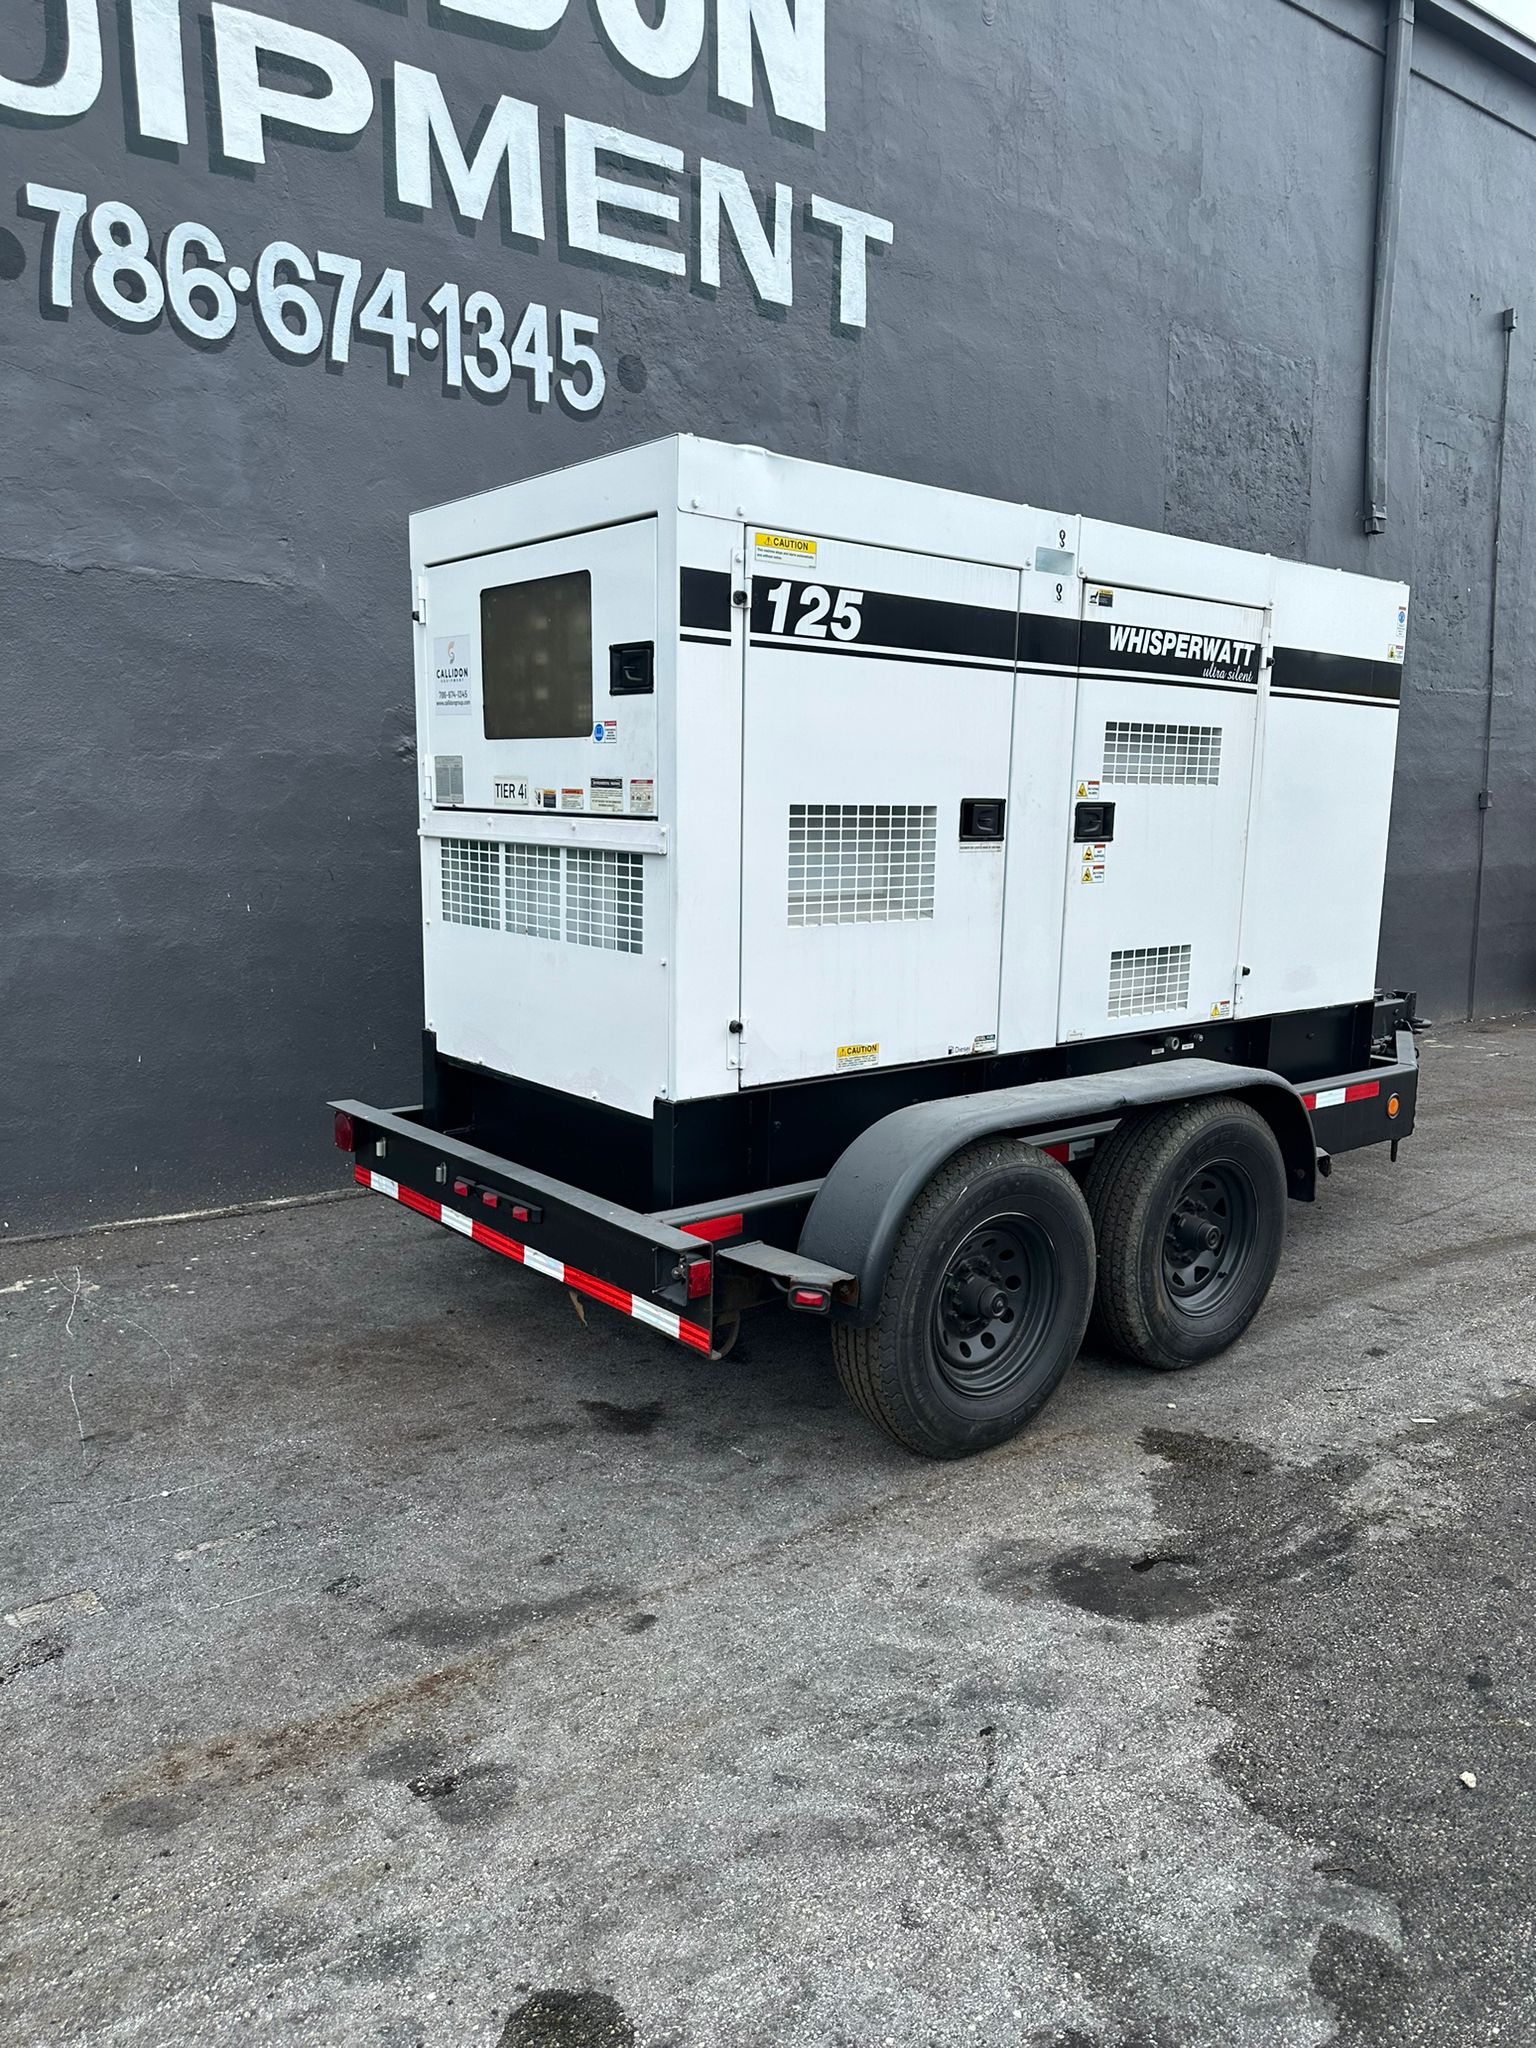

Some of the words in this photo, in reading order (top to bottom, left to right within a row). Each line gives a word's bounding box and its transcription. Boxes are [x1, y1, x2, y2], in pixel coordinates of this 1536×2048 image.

[773, 537, 809, 551] CAUTION
[767, 581, 864, 641] 125
[1109, 625, 1256, 667] WHISPERWATT
[436, 667, 469, 679] CALLIDON
[1202, 660, 1228, 679] ultra
[1228, 665, 1254, 682] silent
[495, 783, 516, 799] TIER
[518, 784, 527, 800] 4i
[846, 1044, 878, 1055] CAUTION
